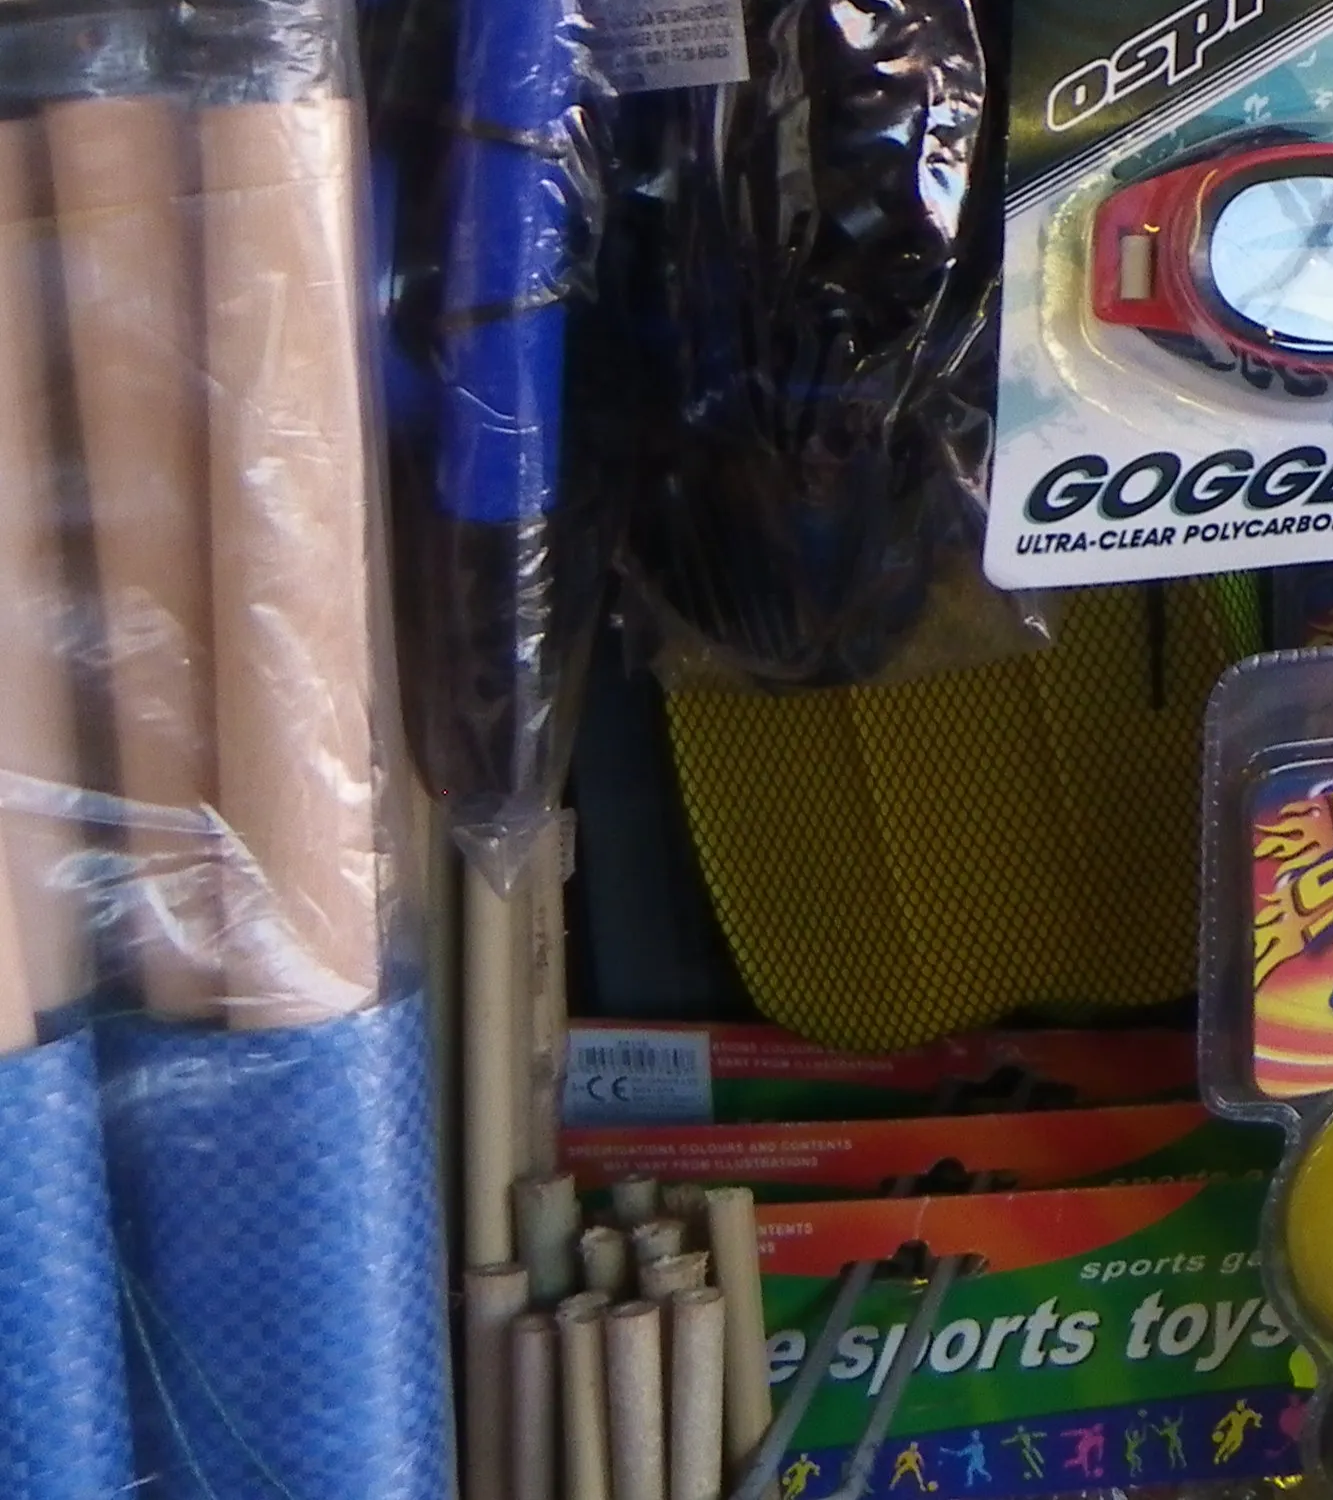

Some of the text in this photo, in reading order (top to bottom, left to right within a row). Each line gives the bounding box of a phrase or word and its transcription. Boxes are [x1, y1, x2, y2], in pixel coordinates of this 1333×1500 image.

[1016, 524, 1175, 557] ULTRA-CLEAR
[1079, 1248, 1207, 1285] sports
[829, 1293, 1103, 1399] sports
